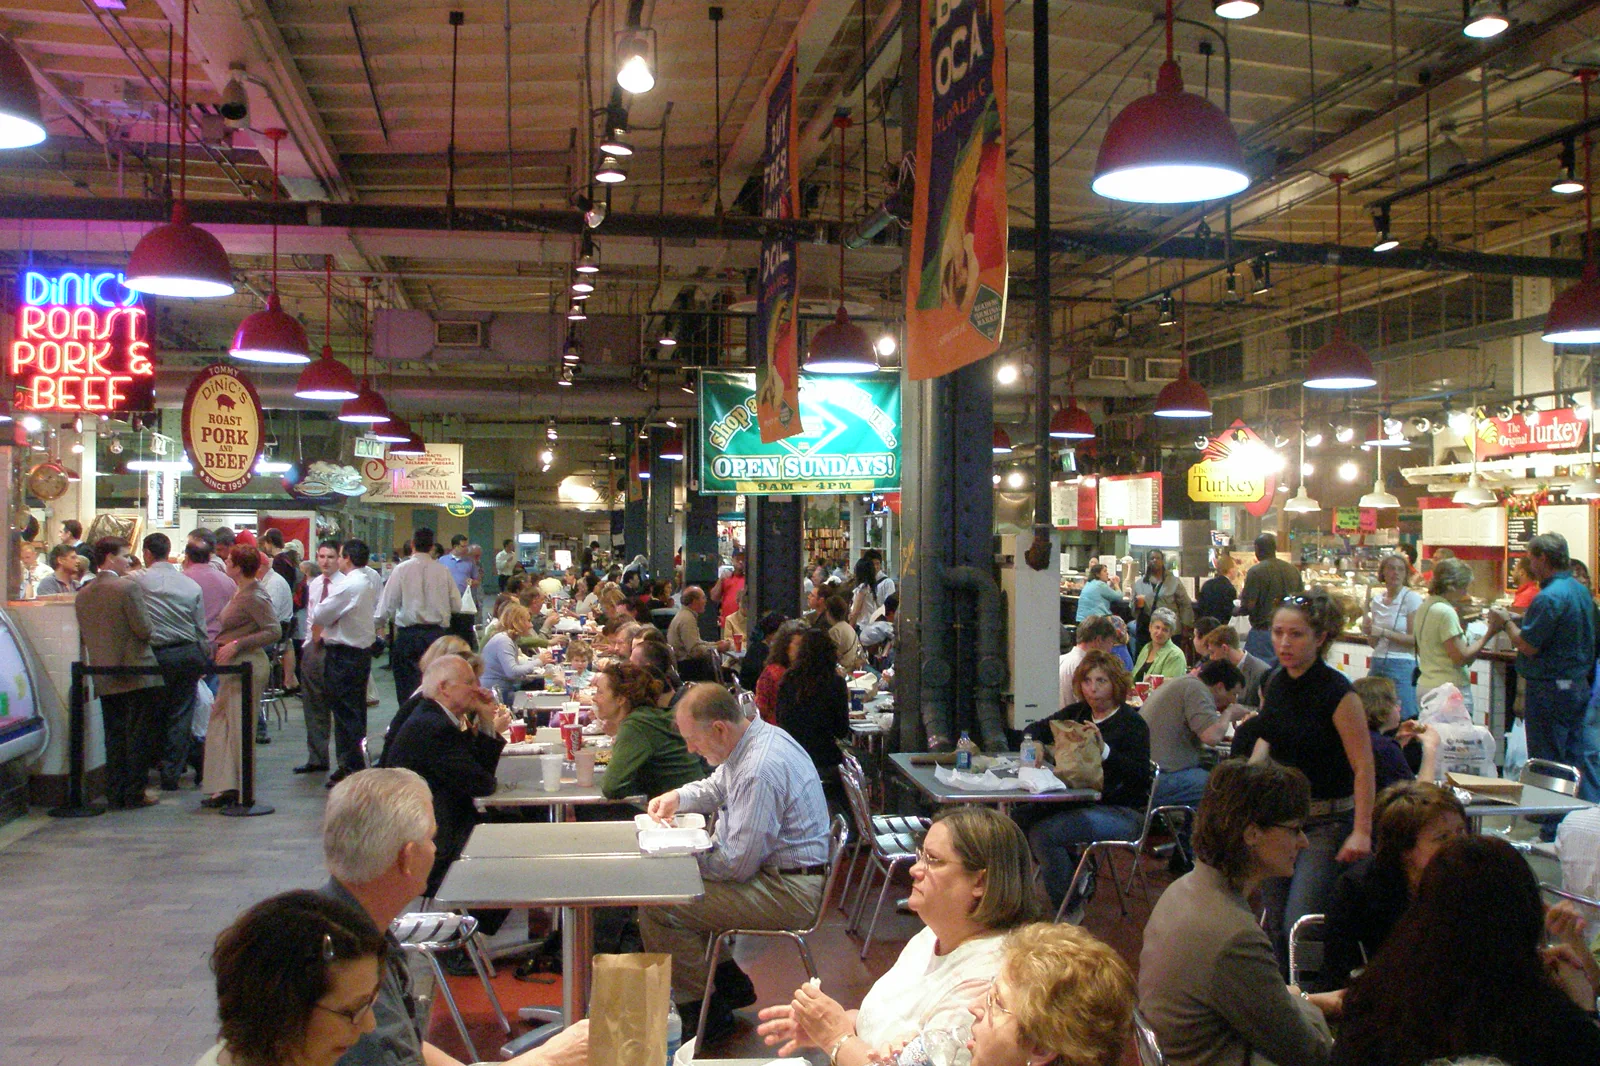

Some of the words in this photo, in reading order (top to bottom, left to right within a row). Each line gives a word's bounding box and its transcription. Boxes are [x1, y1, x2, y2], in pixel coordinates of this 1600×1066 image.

[22, 306, 146, 340] ROAST
[13, 341, 112, 375] PORK
[128, 341, 153, 375] &
[208, 365, 241, 378] TOMMY
[32, 375, 133, 410] BEEF
[208, 413, 242, 426] ROAST
[201, 426, 249, 446] PORK
[1507, 423, 1520, 433] The
[1528, 416, 1583, 449] Turkey
[1498, 433, 1528, 448] Original
[218, 445, 233, 453] AND
[204, 452, 248, 470] BEEF
[714, 455, 780, 479] OPEN
[784, 454, 894, 478] SUNDAYS!
[1193, 465, 1208, 475] The
[204, 476, 226, 491] SINCE
[228, 477, 247, 491] 1954
[757, 482, 794, 491] 9AM
[815, 482, 852, 490] 4PM
[1193, 475, 1256, 497] Turkey
